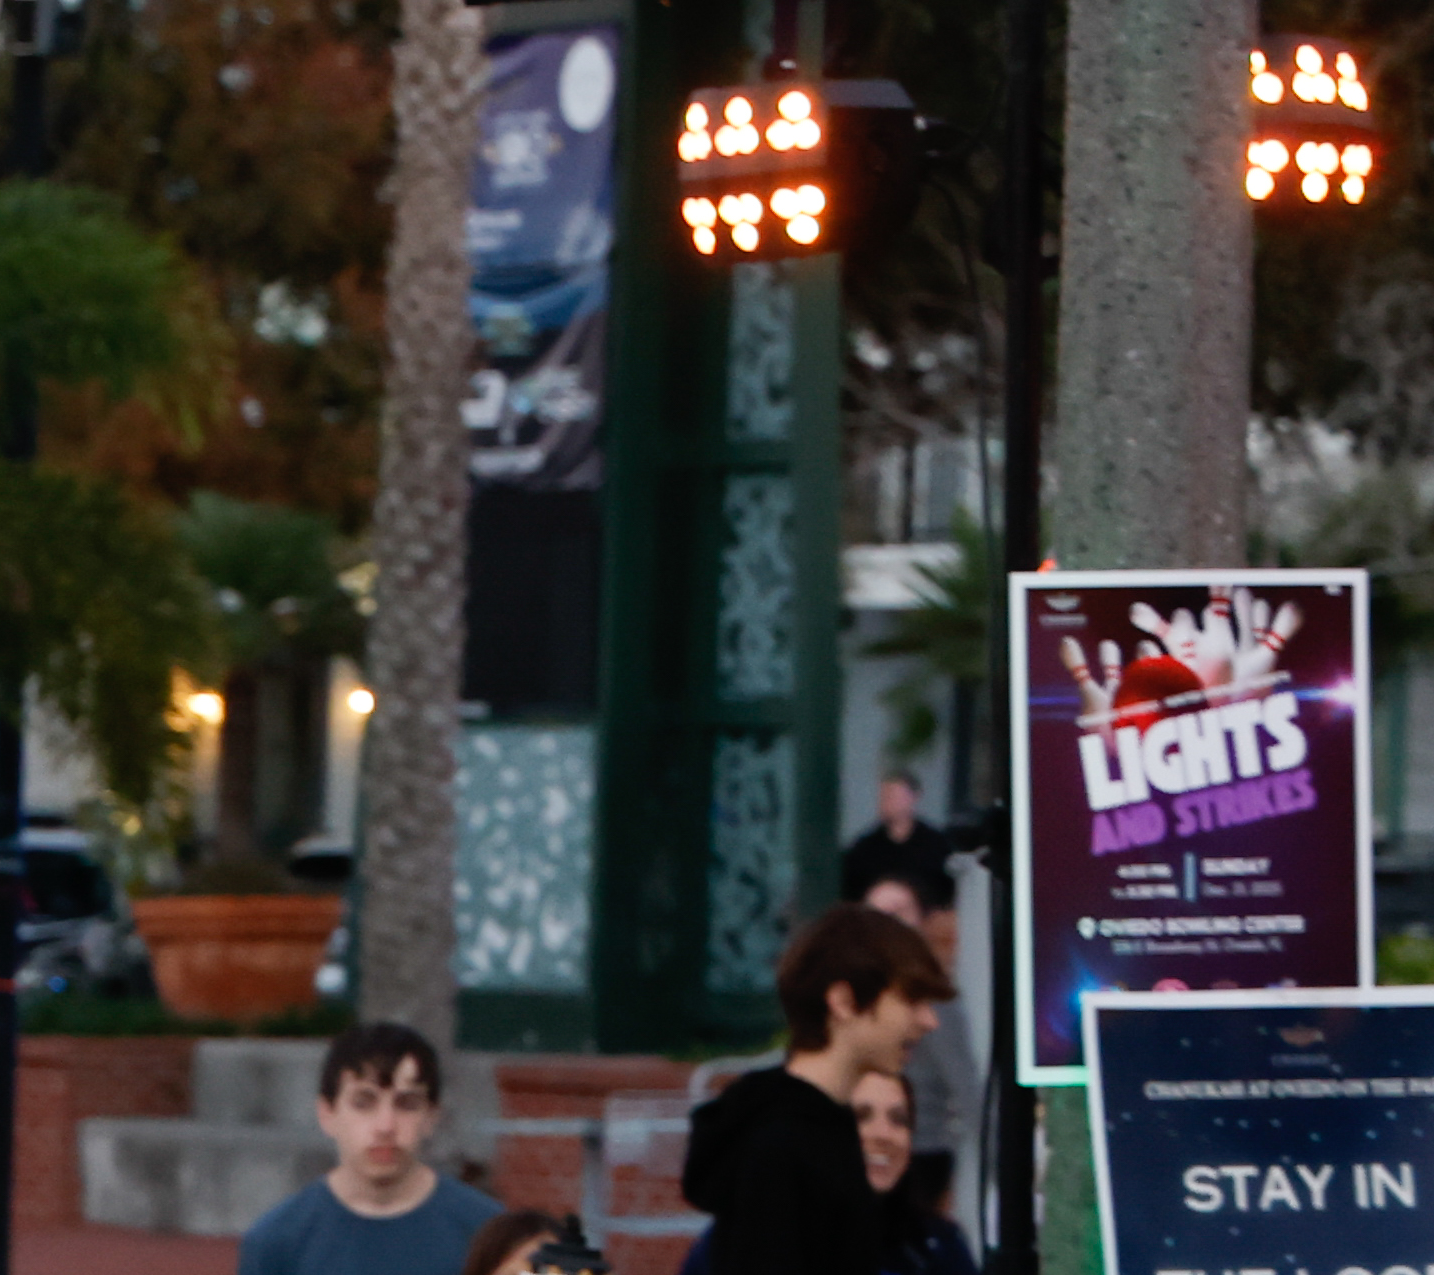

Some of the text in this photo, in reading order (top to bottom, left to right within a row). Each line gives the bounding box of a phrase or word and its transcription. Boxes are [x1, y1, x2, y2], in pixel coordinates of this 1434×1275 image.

[1077, 691, 1309, 812] LIGHTS
[1092, 768, 1318, 856] AND STRIKES
[1182, 1161, 1417, 1213] STAY IN
